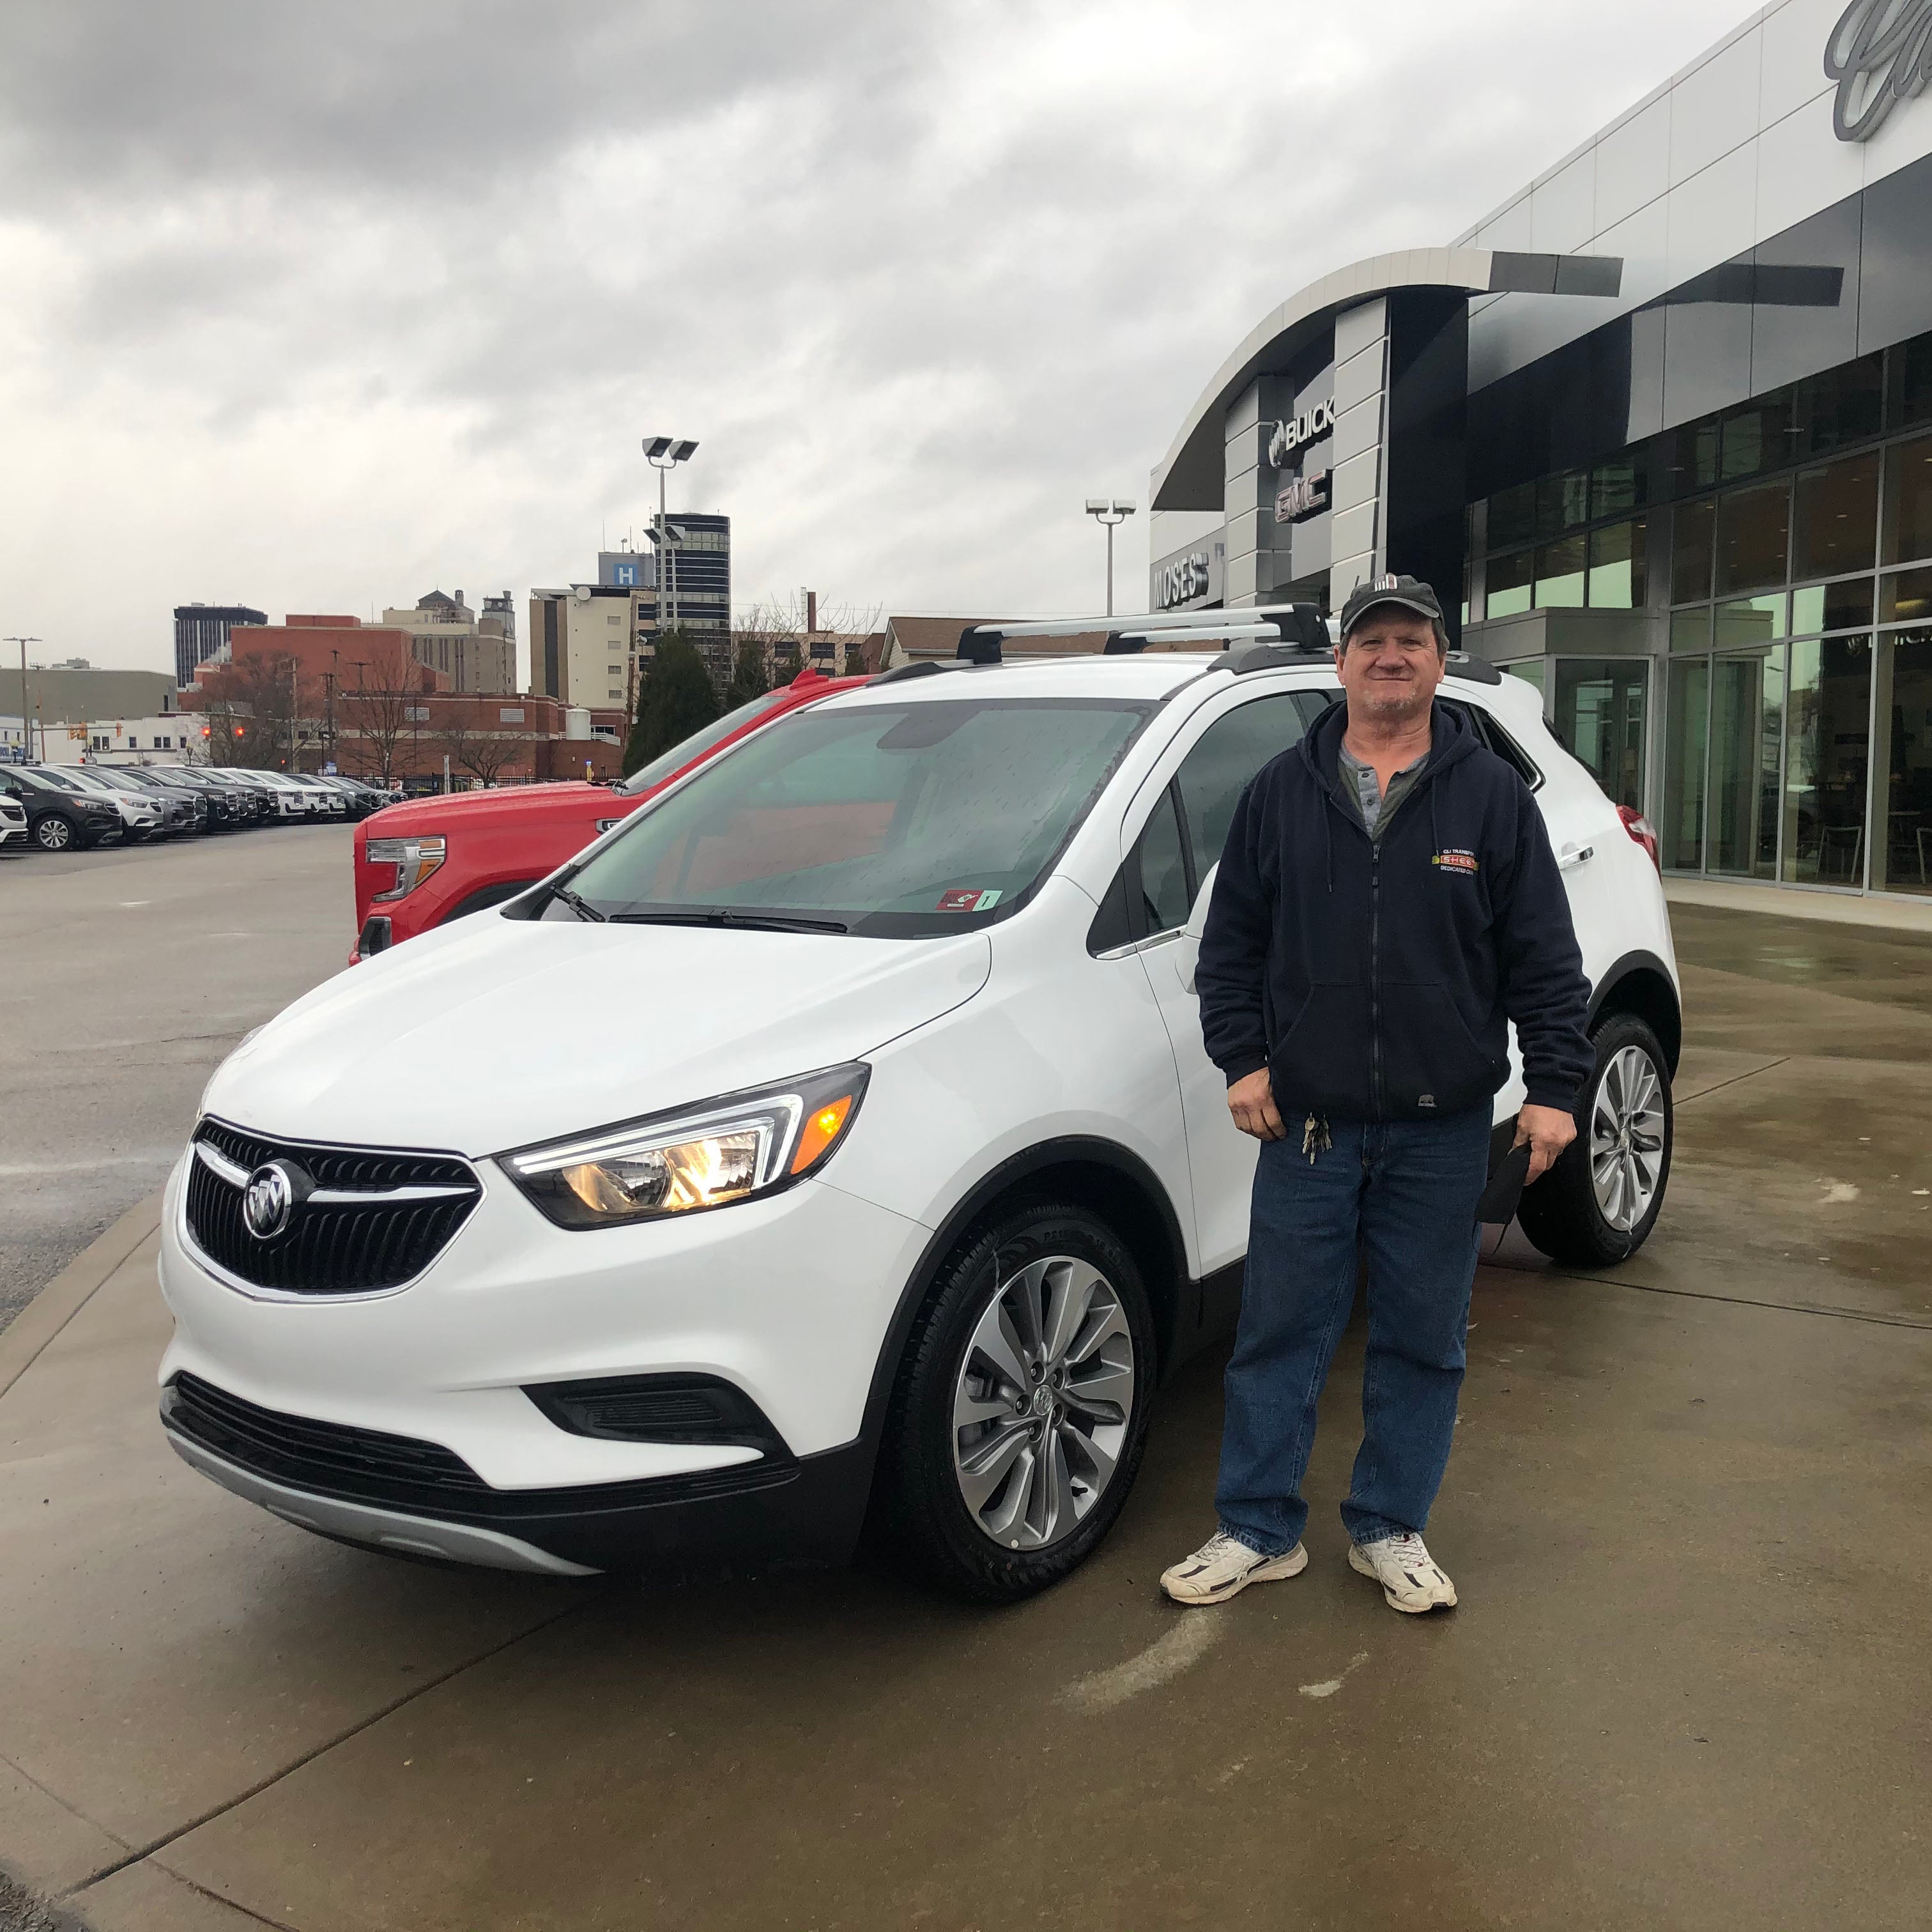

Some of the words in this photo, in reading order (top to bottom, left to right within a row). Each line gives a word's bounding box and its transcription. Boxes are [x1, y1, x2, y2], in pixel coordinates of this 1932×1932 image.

[1285, 395, 1335, 451] BUICK
[1275, 468, 1326, 523] GMC
[619, 567, 633, 585] H
[1154, 552, 1198, 609] MOSES
